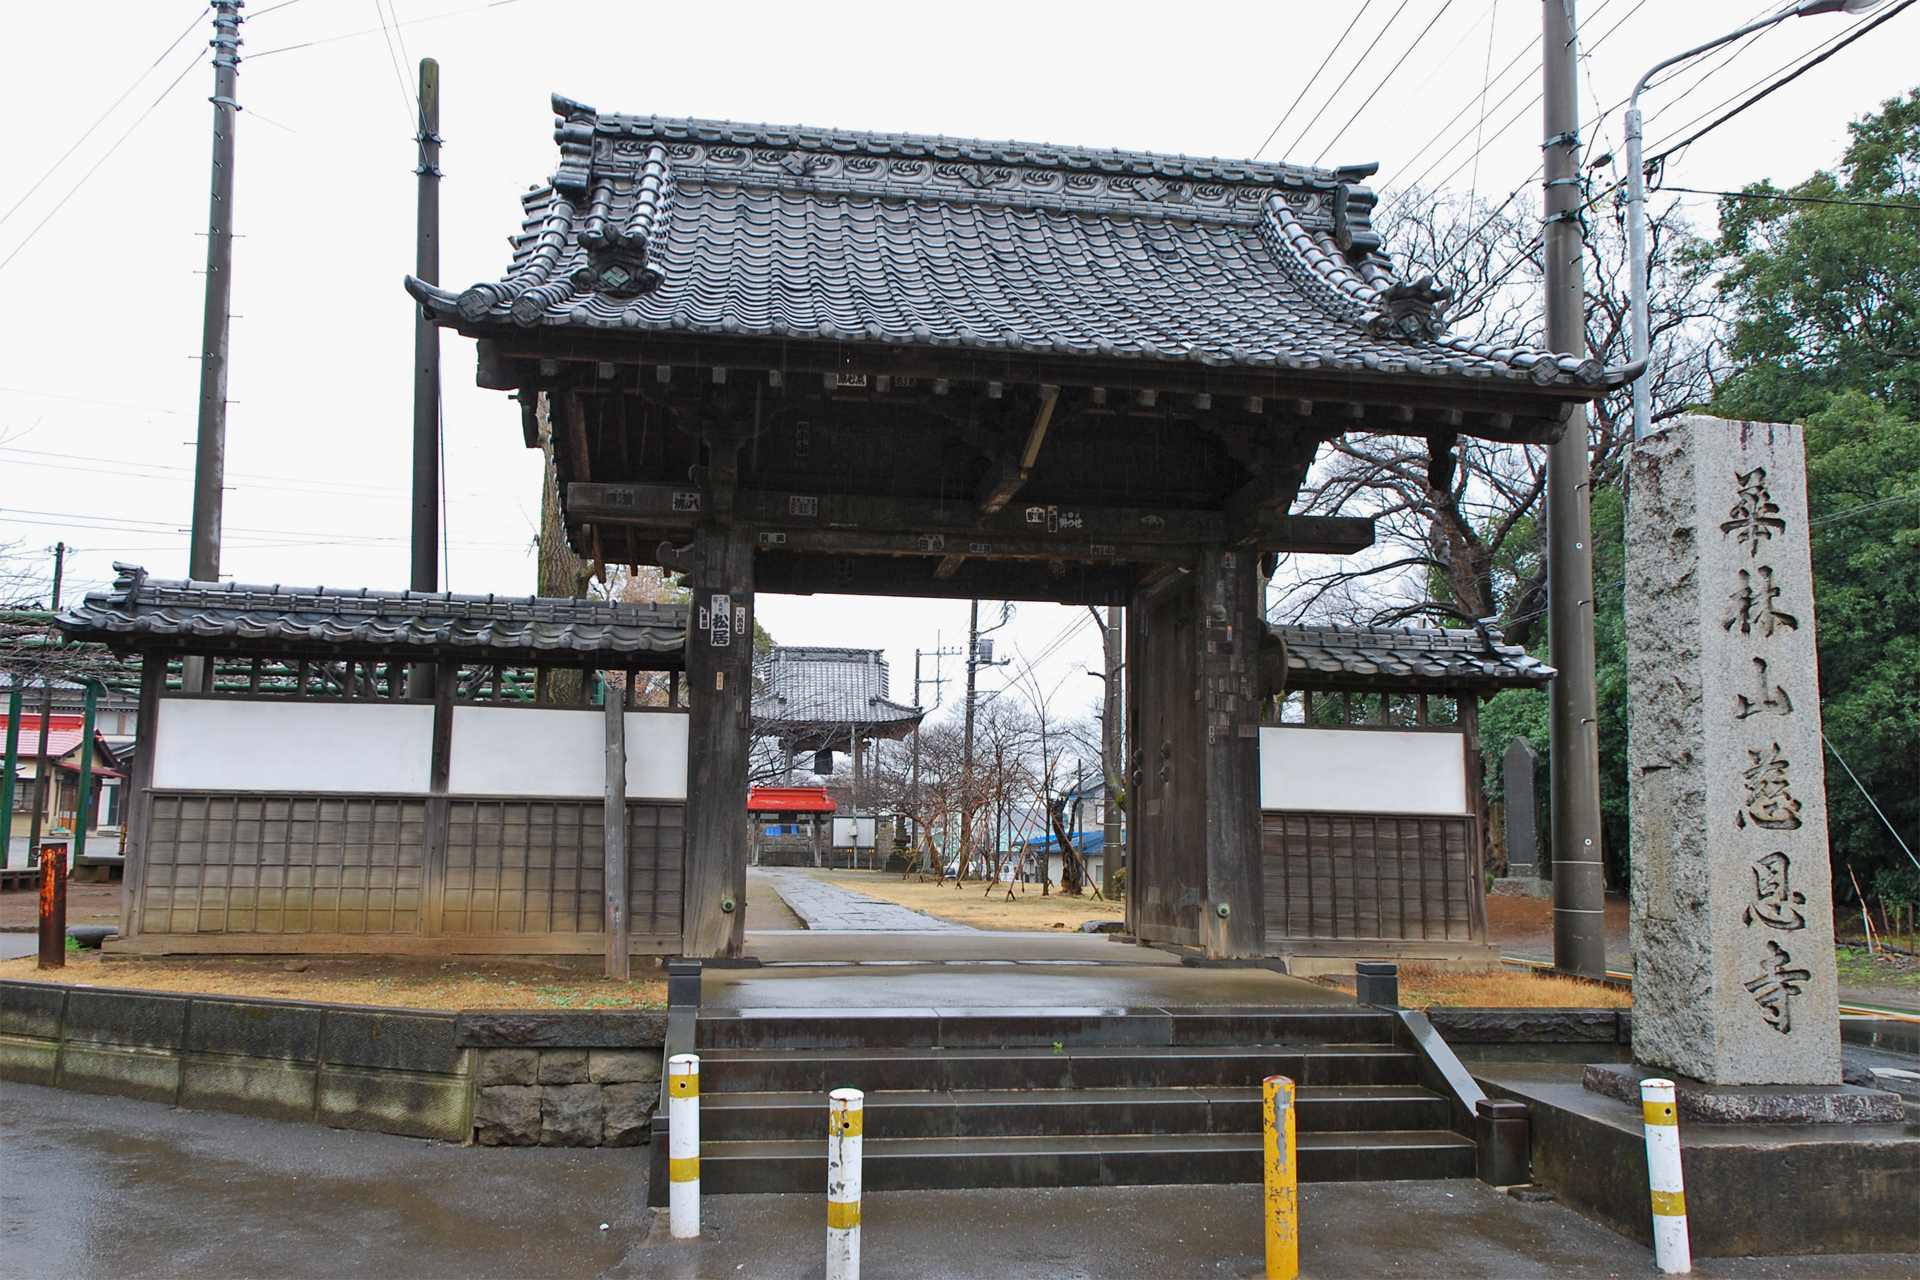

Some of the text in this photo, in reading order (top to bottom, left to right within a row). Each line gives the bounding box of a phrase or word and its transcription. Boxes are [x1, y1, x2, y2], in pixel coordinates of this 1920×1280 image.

[1719, 465, 1811, 1034] 華林山慈恩寺
